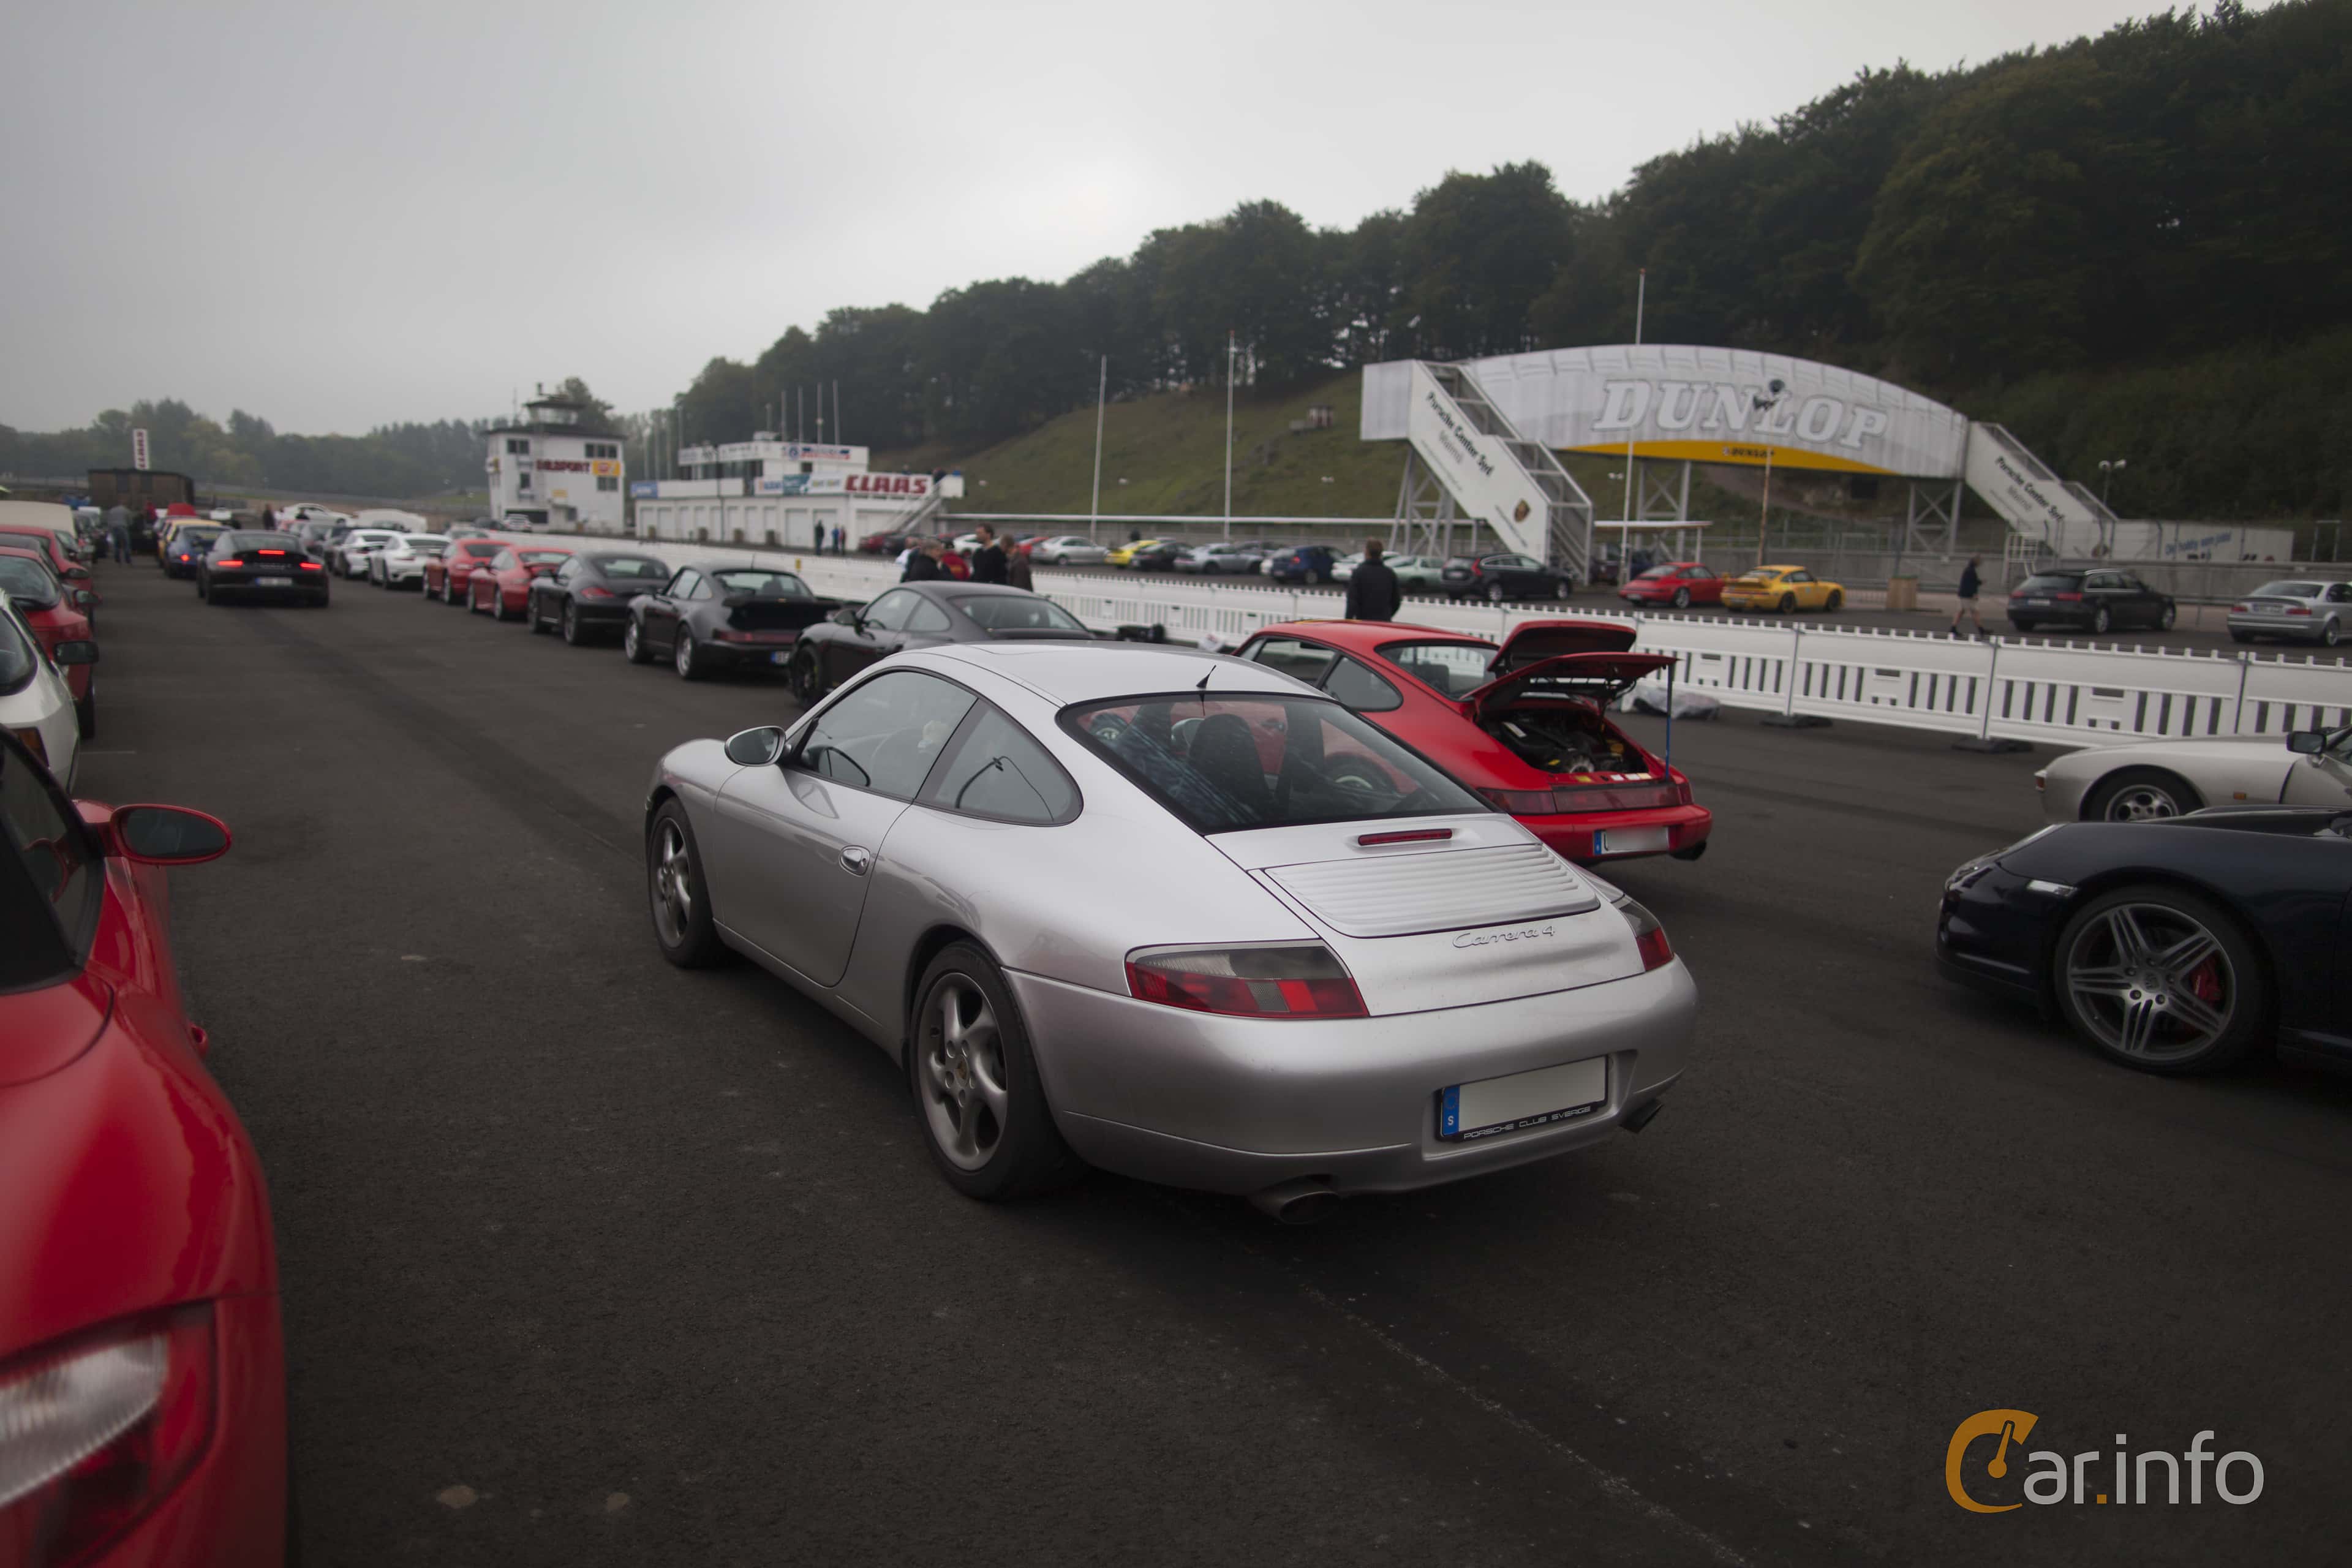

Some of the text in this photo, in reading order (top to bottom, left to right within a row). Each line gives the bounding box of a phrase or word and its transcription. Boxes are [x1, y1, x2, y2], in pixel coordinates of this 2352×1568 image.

[1593, 378, 1888, 450] DUNLOP
[1732, 446, 1775, 458] DUNLO
[845, 474, 930, 495] CLAAS
[1452, 925, 1556, 948] Carrera 4
[1447, 1115, 1454, 1126] S
[1463, 1123, 1515, 1140] PORSCHE
[1518, 1115, 1548, 1128] CLUB
